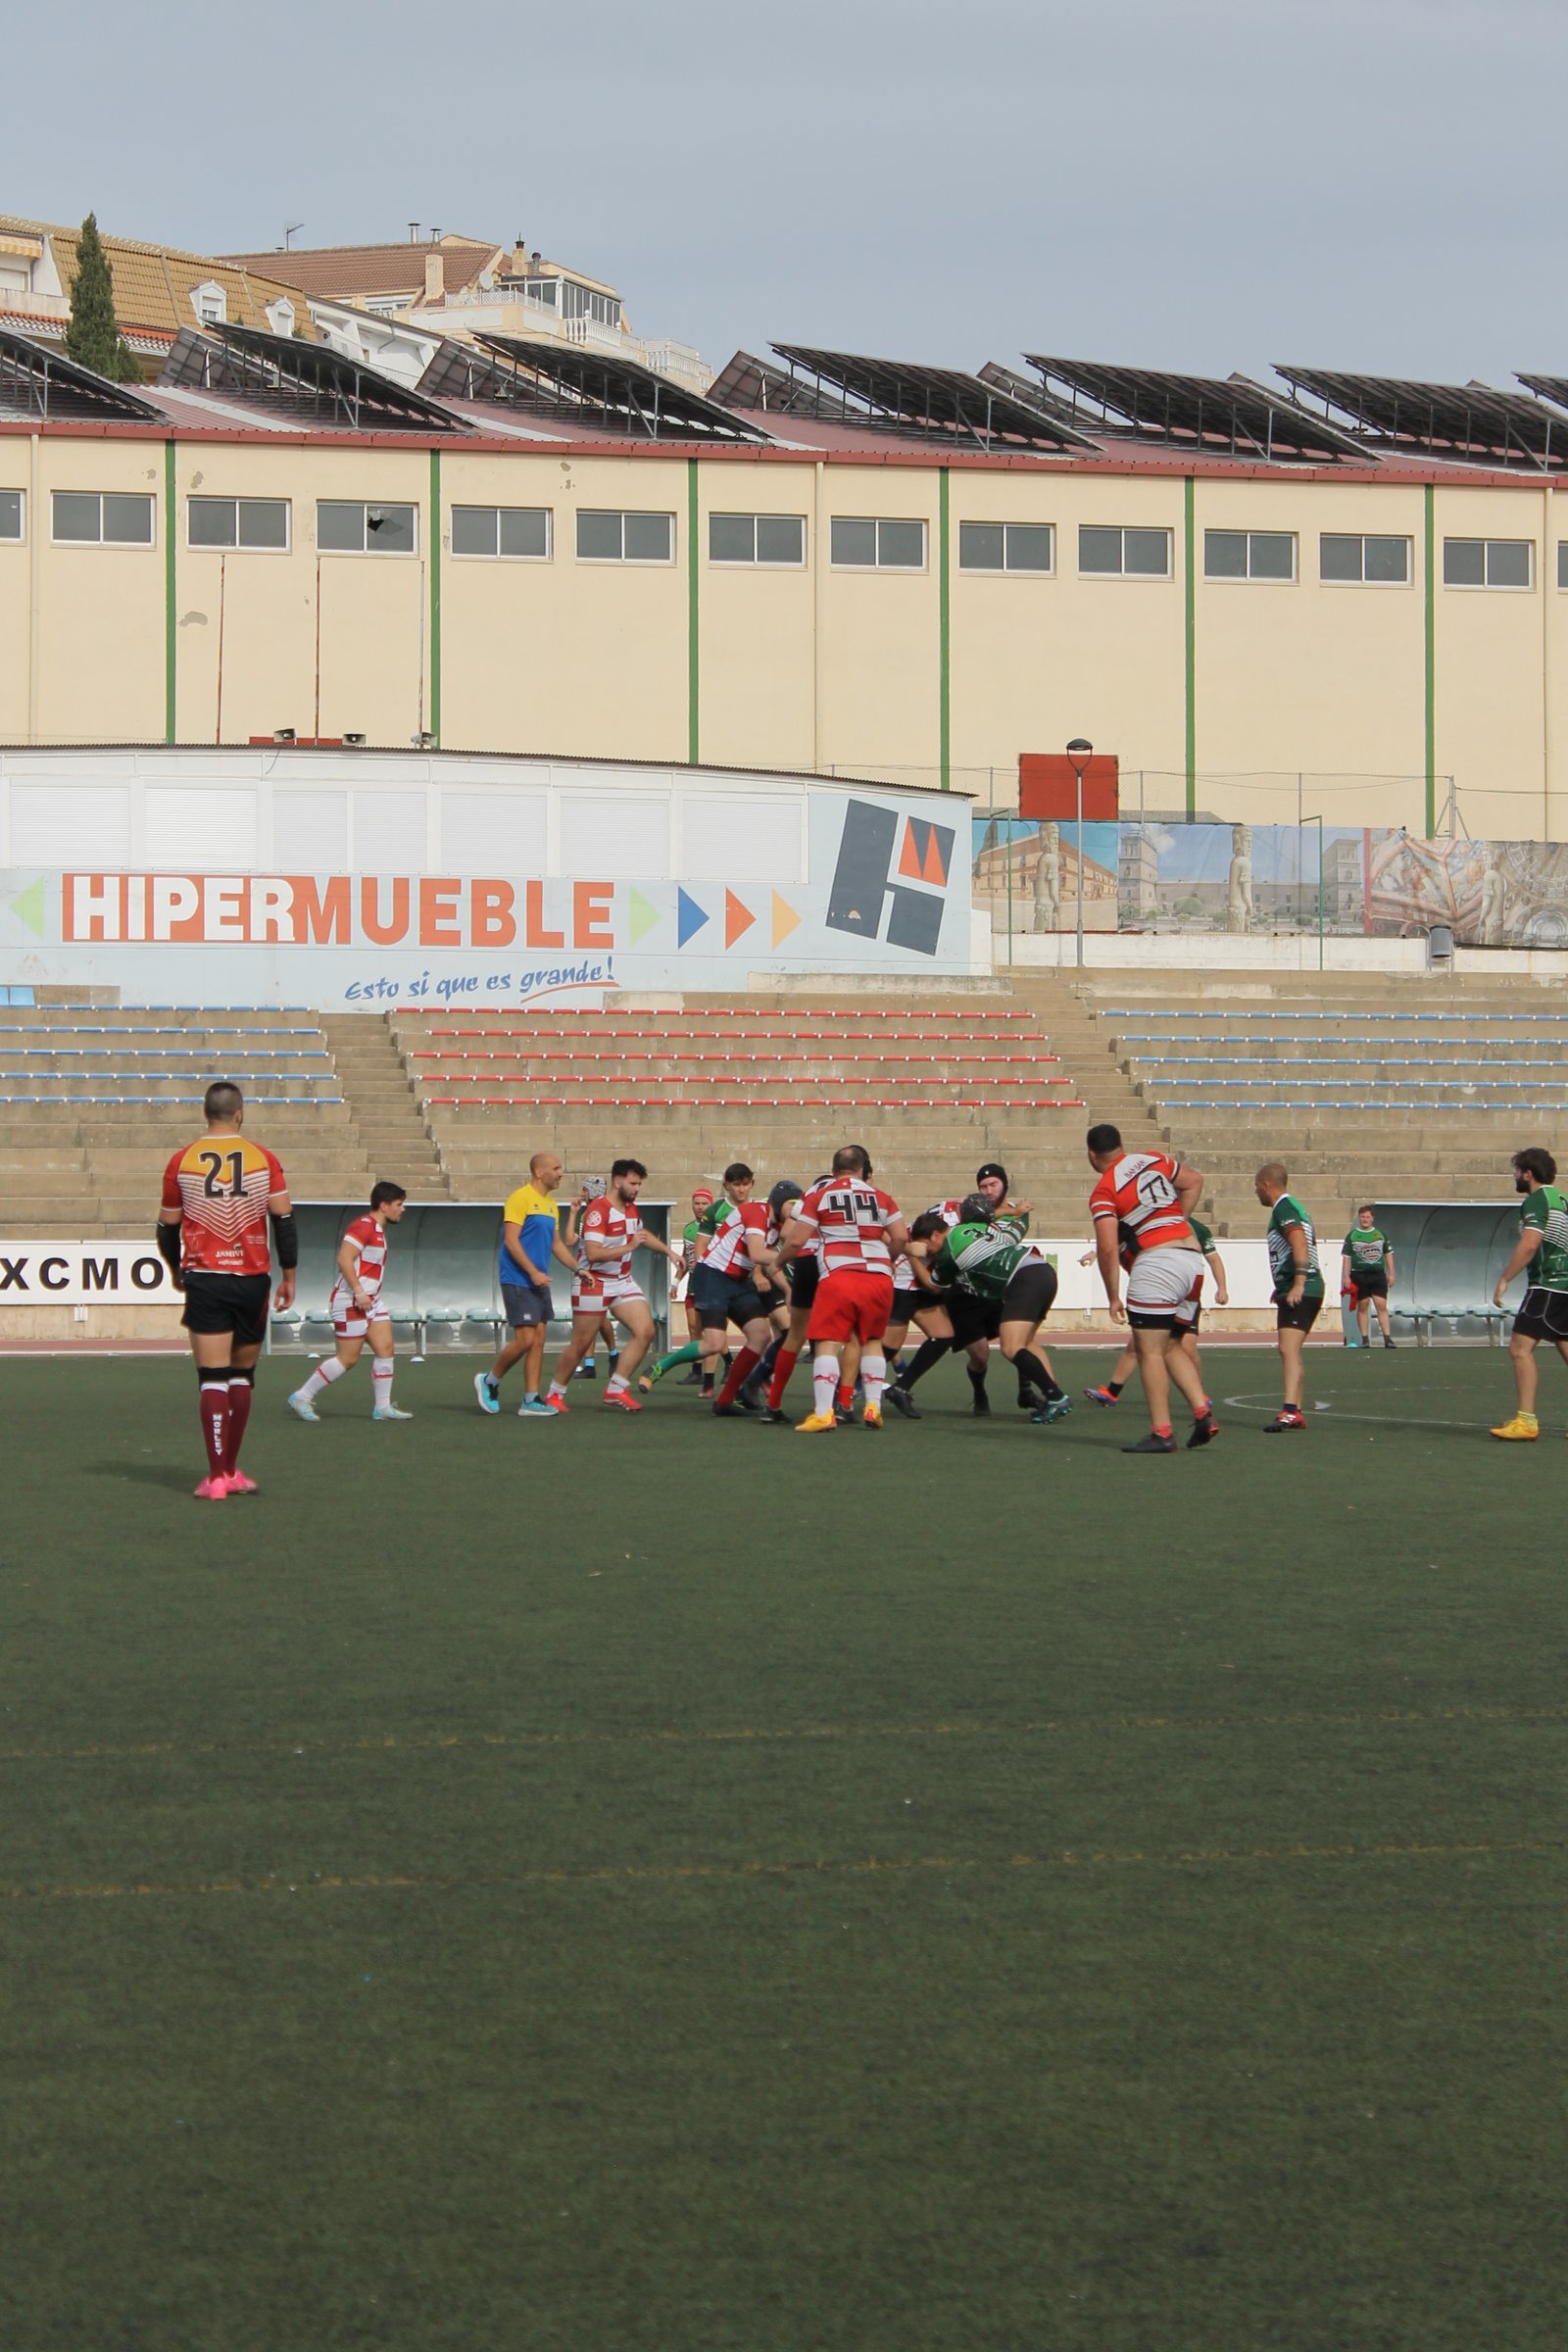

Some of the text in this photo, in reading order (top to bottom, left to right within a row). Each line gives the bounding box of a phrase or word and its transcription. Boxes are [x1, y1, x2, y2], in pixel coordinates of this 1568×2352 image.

[71, 873, 615, 950] HIPERMUEBLE
[344, 977, 399, 1001] Esto
[436, 976, 479, 1003] que
[486, 972, 512, 990] es
[519, 956, 615, 994] grande!
[198, 1151, 249, 1199] 21
[1140, 1175, 1169, 1203] 77
[827, 1193, 880, 1223] 44
[213, 1413, 222, 1456] MORLEY
